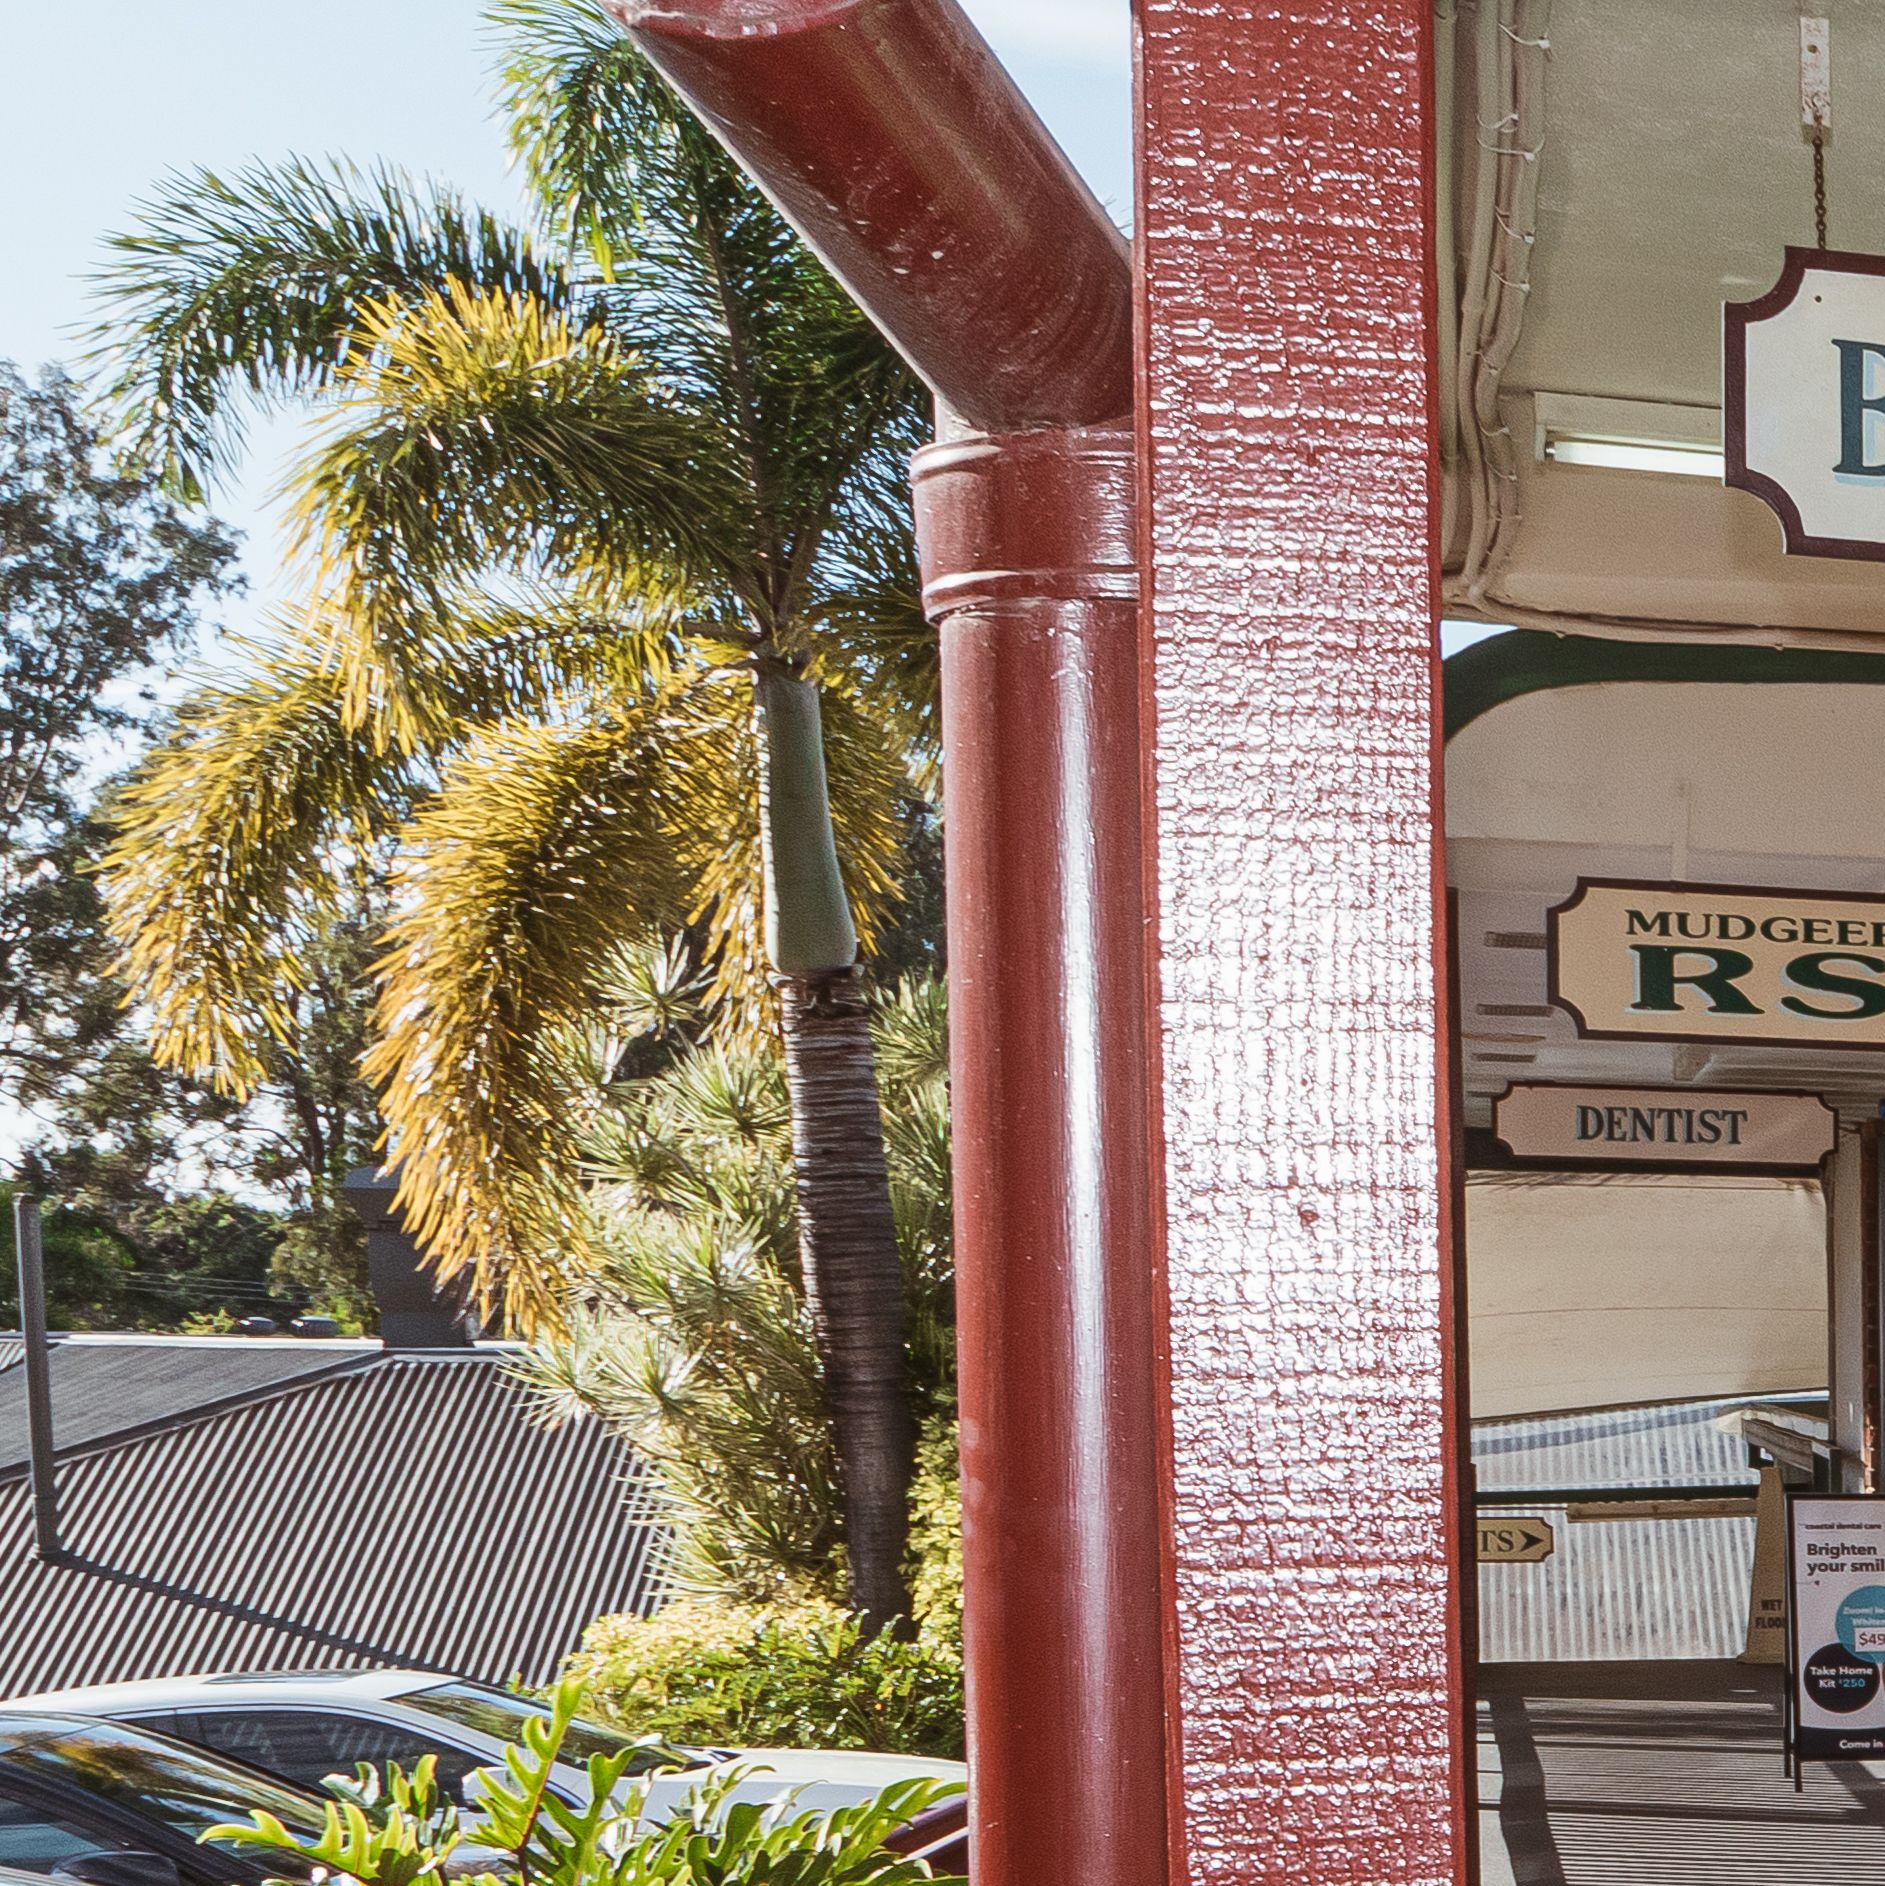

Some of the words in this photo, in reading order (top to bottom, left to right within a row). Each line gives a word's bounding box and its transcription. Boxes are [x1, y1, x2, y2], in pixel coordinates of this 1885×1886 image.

[1575, 1105, 1748, 1145] DENTIST
[1807, 1543, 1877, 1559] Brighten
[1806, 1562, 1847, 1576] your
[1761, 1600, 1782, 1611] WET
[1810, 1666, 1837, 1676] Take
[1839, 1666, 1873, 1676] Home
[1819, 1680, 1836, 1688] Kit
[1839, 1739, 1871, 1749] Come
[1873, 1739, 1884, 1748] in
